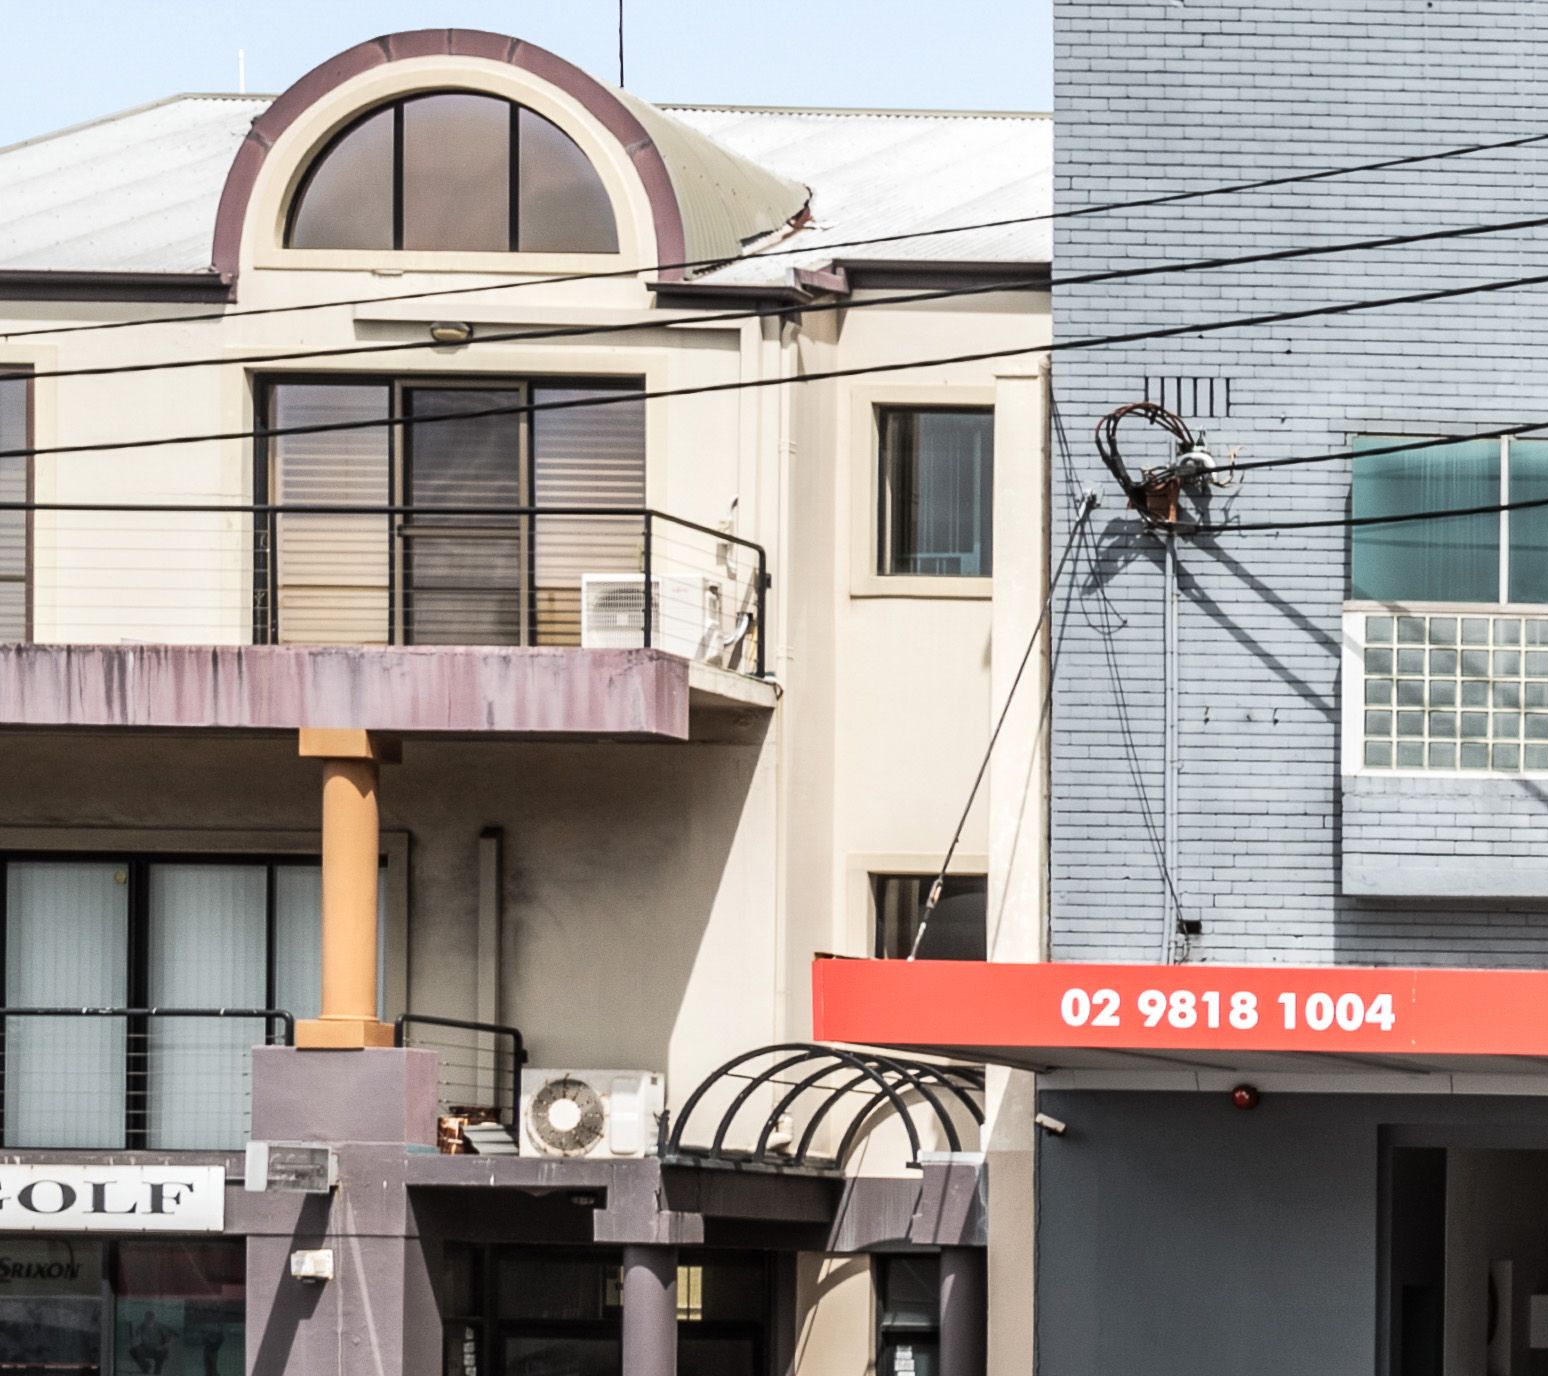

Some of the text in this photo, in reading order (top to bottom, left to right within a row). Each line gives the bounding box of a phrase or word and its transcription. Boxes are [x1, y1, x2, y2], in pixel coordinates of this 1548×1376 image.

[1060, 988, 1396, 1031] 02 9818 1004
[0, 1179, 194, 1214] OLF
